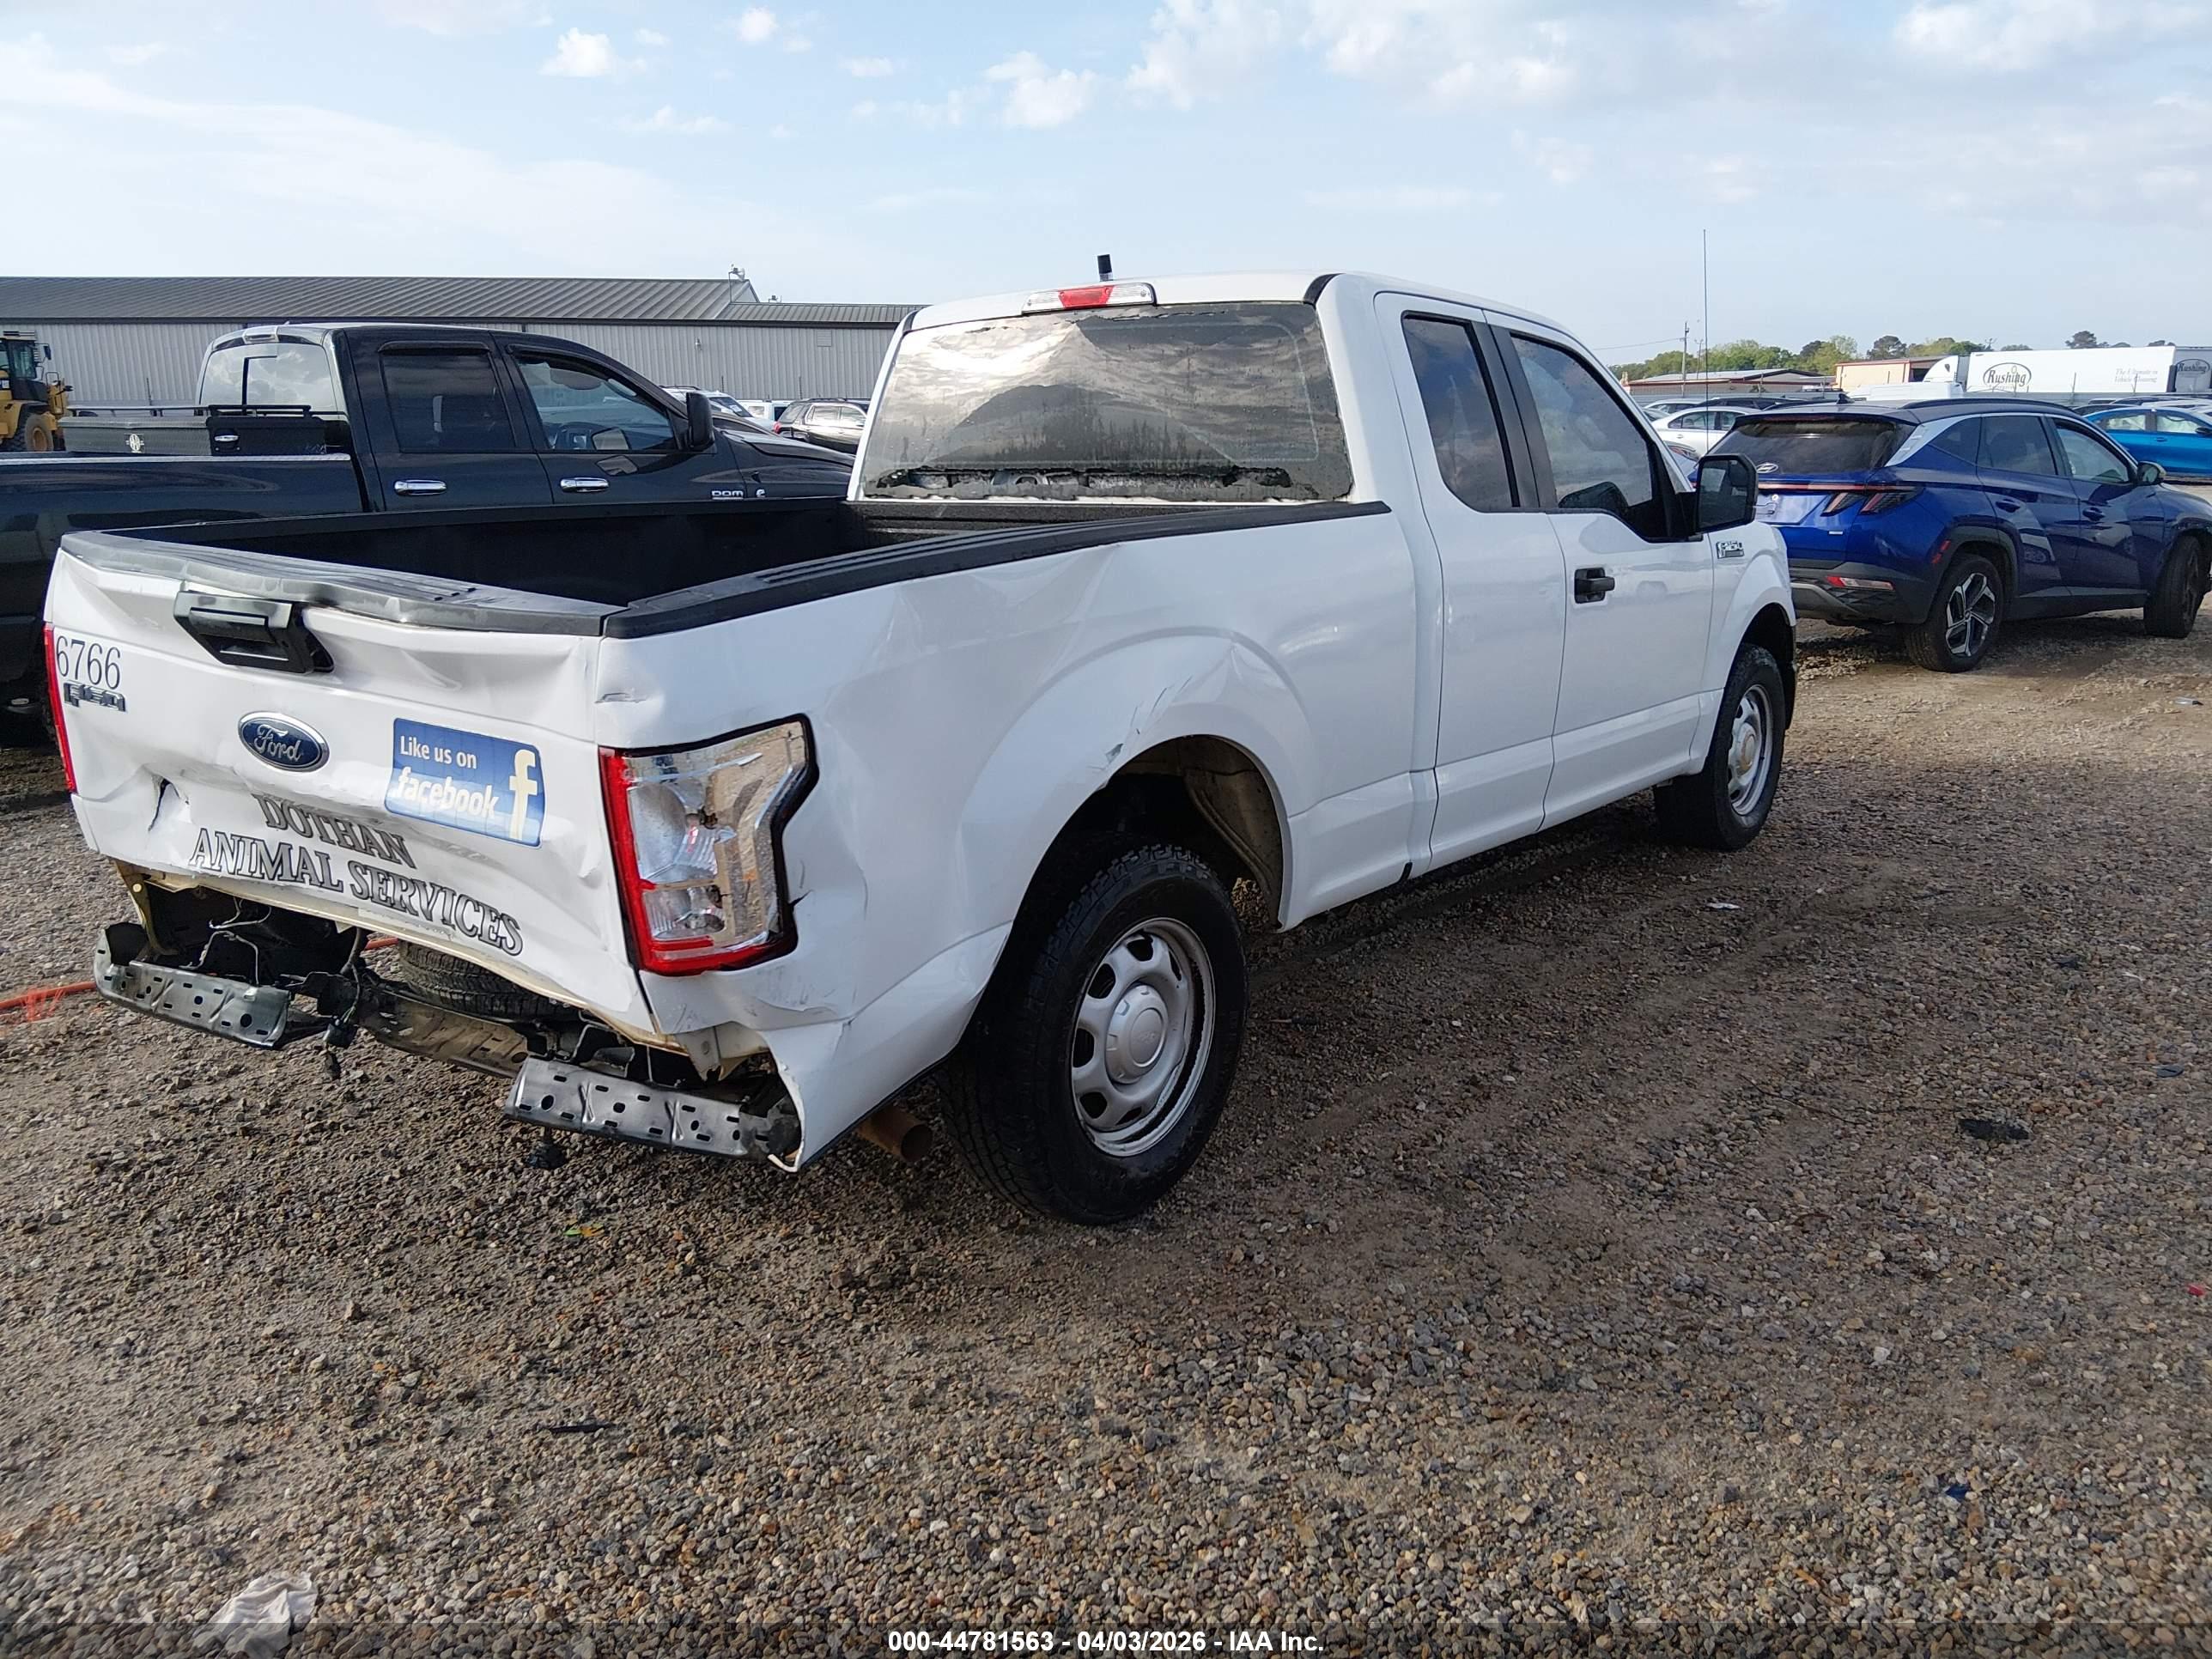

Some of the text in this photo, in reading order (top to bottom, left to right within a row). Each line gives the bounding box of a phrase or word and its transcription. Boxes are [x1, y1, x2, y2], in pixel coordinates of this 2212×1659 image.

[1987, 369, 2027, 386] Rushing
[56, 635, 121, 690] 6766
[254, 724, 301, 762] Ford
[400, 735, 477, 769] Like us on
[398, 766, 500, 819] facebook
[250, 793, 417, 869] DOTHAN
[188, 827, 524, 956] ANIMAL SERVICES
